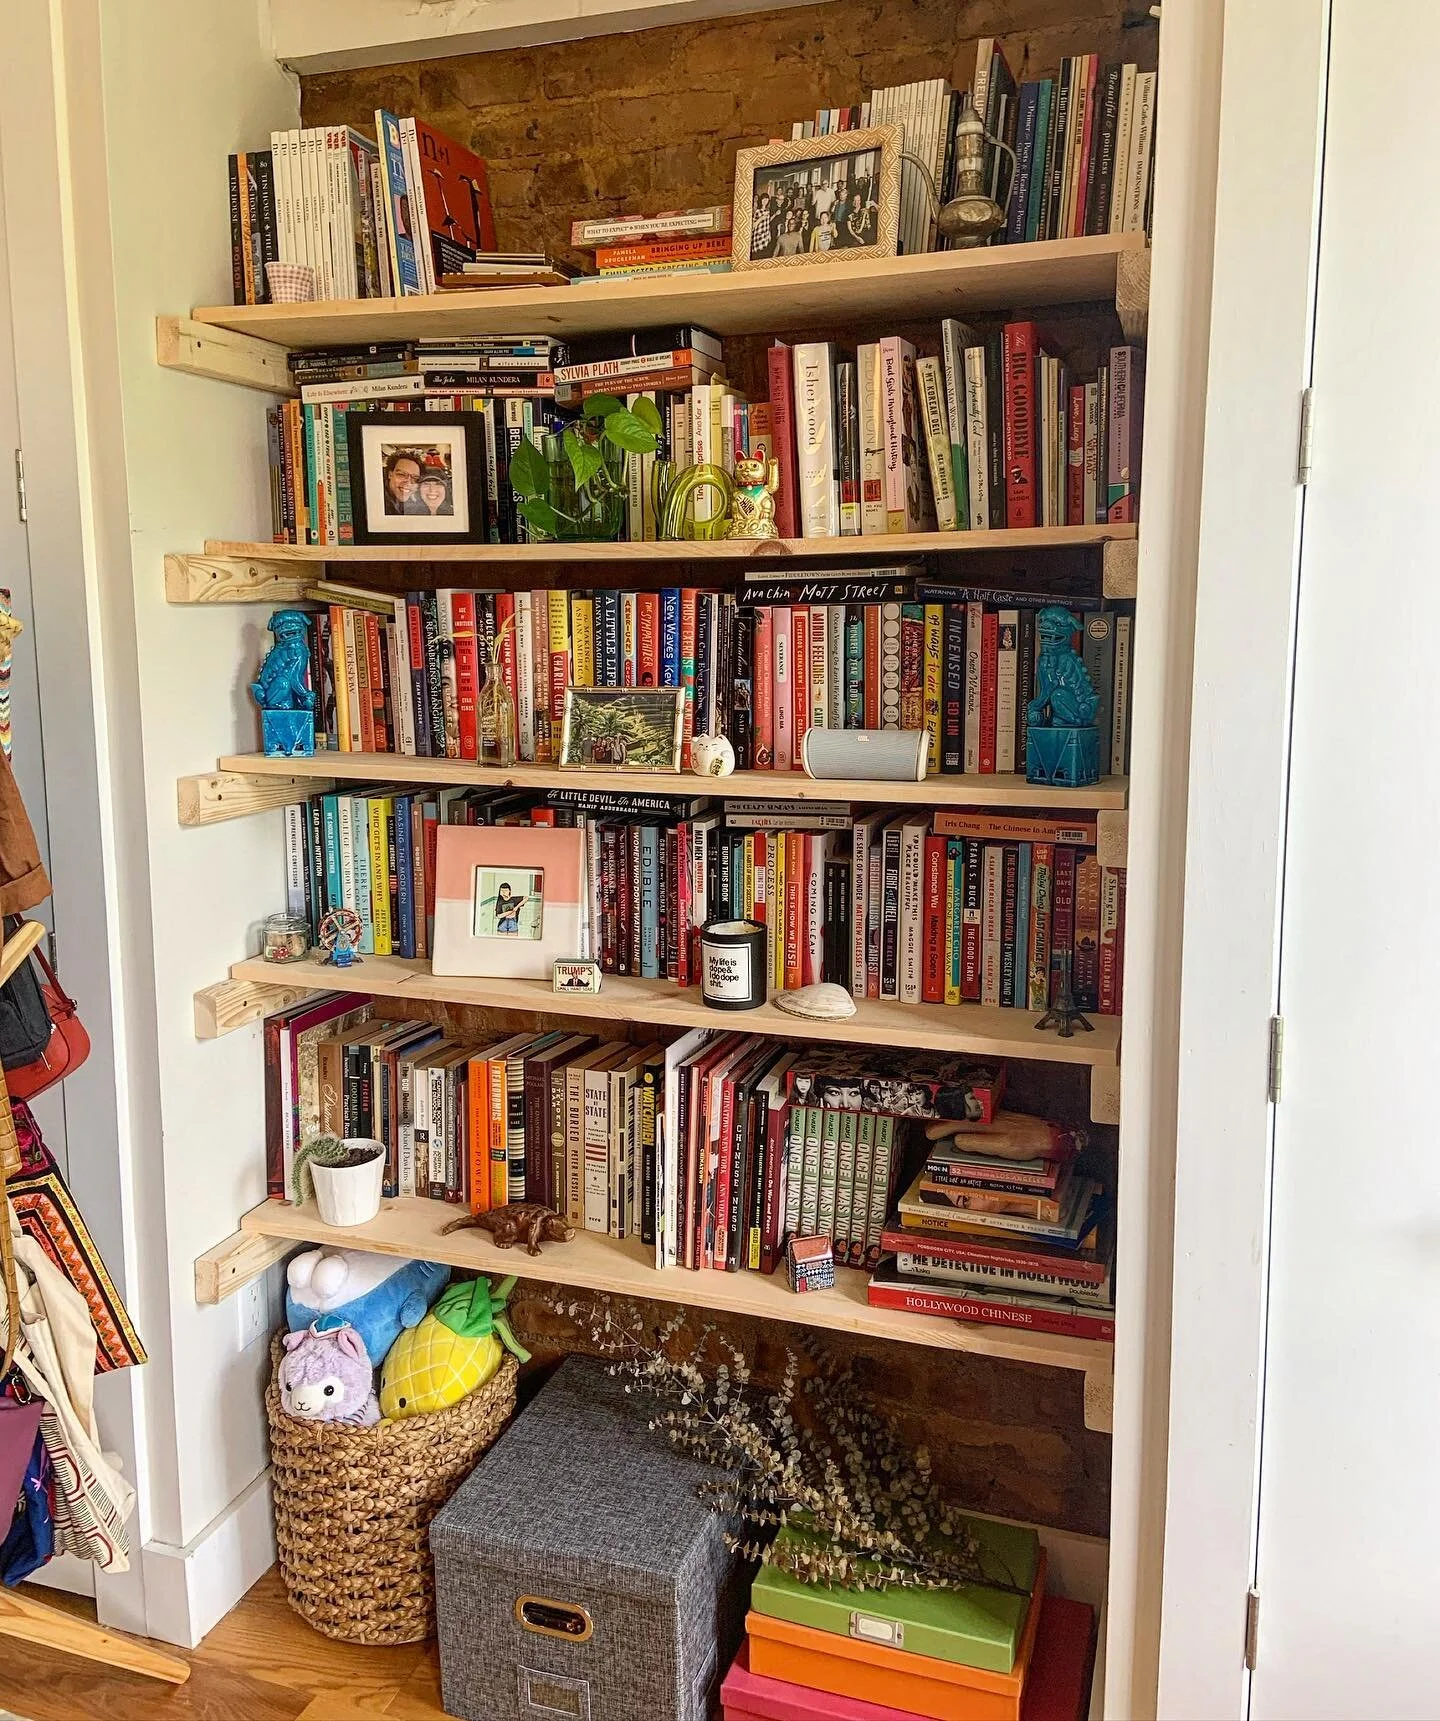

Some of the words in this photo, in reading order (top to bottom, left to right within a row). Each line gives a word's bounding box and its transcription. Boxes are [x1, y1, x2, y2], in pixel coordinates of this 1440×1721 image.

[1106, 71, 1118, 118] Beautiful
[1142, 77, 1152, 103] William
[1024, 106, 1035, 132] Primer
[1140, 104, 1150, 126] Carlos
[1022, 142, 1032, 163] Poets
[1101, 132, 1112, 175] pointless
[1138, 126, 1147, 155] Williams
[1018, 173, 1028, 202] Readers
[1133, 160, 1144, 210] IMAGINATIONS
[1014, 210, 1025, 236] Poetry
[1015, 332, 1026, 348] The
[561, 366, 589, 381] SYLVIA
[592, 362, 620, 376] PLATH
[886, 357, 894, 376] Bad
[924, 372, 933, 383] MY
[1012, 352, 1028, 380] BIG
[1116, 351, 1126, 384] SOUTHERN
[372, 384, 386, 392] Milan
[432, 375, 442, 384] The
[442, 375, 456, 384] Joke
[466, 376, 488, 384] MILAN
[885, 377, 896, 397] Girls
[804, 364, 821, 447] Isherwood
[926, 385, 938, 416] KOREAN
[944, 366, 952, 388] ANNA
[950, 405, 958, 432] WONG
[968, 376, 984, 418] Perpetually
[1116, 384, 1126, 418] CALIFORNIA
[886, 398, 897, 440] Throughout
[930, 418, 940, 436] DELI
[972, 420, 986, 438] Cool
[1012, 384, 1030, 460] GOODBYE
[888, 441, 898, 472] History
[606, 596, 616, 605] A
[766, 586, 790, 599] Chin
[666, 596, 676, 620] New
[682, 599, 694, 626] TRUST
[698, 606, 706, 620] All
[355, 618, 366, 662] GOLDEN
[606, 608, 616, 654] LITTLE
[640, 612, 654, 668] SYMPATHIZER
[698, 622, 706, 639] You
[812, 612, 825, 642] MINOR
[426, 621, 438, 684] REMEMBERING
[666, 624, 676, 658] Waves
[682, 630, 694, 670] EXERCISE
[737, 622, 748, 676] Orientalism
[948, 618, 962, 690] INCENSED
[358, 666, 367, 686] BOY
[554, 655, 564, 690] CHARLIE
[606, 658, 617, 687] LIFE
[697, 662, 705, 682] Ever
[812, 645, 825, 684] FEELINGS
[430, 686, 440, 732] SHANGHAI
[554, 694, 564, 717] CHAN
[696, 684, 705, 710] Know
[947, 701, 960, 716] ED
[778, 720, 784, 730] MA
[947, 718, 960, 736] LIN
[396, 804, 406, 844] CHASING
[856, 828, 864, 842] THE
[694, 830, 704, 845] MAD
[695, 846, 704, 861] MEN
[856, 842, 864, 862] SENSE
[969, 842, 978, 868] PEARL
[642, 846, 652, 908] EDIBLE
[696, 862, 704, 894] UNBUTTONED
[767, 844, 776, 896] PROCESS
[856, 864, 863, 872] OF
[930, 852, 940, 894] Constance
[969, 872, 978, 881] S.
[810, 872, 818, 914] COMING
[930, 895, 939, 908] Wu
[968, 885, 978, 907] BUCK
[634, 934, 640, 943] IN
[790, 930, 796, 940] WE
[810, 920, 818, 955] CLEAN
[967, 928, 975, 940] THE
[709, 956, 719, 966] My
[719, 957, 730, 966] life
[730, 957, 737, 966] is
[788, 942, 798, 966] RISE
[868, 944, 879, 976] FAIREST
[967, 942, 975, 959] GOOD
[556, 966, 593, 976] TRUMP'S
[709, 972, 712, 980] I
[712, 972, 722, 980] do
[722, 974, 739, 983] dope
[710, 964, 726, 975] dope
[726, 966, 732, 974] &
[966, 962, 975, 982] EARTH
[1004, 952, 1012, 977] WESLEY
[1004, 978, 1012, 996] YANG
[402, 1066, 410, 1077] The
[402, 1078, 410, 1090] GOD
[351, 1082, 359, 1122] DOORMEN
[402, 1092, 410, 1119] Delusion
[491, 1065, 502, 1121] FREAKONOMICS
[570, 1086, 580, 1102] THE
[586, 1088, 607, 1100] STATE
[570, 1107, 580, 1142] BURIED
[586, 1105, 608, 1118] STATE
[642, 1086, 654, 1146] WATCHMEN
[722, 1090, 730, 1134] CHINATOWN
[402, 1122, 411, 1150] Richard
[571, 1150, 579, 1170] PETER
[720, 1154, 728, 1174] YORK
[790, 1134, 802, 1170] ONCE
[403, 1152, 411, 1182] Dawkins
[572, 1172, 580, 1202] HESSLER
[788, 1180, 801, 1206] WAS
[786, 1208, 800, 1231] YOU
[921, 1218, 949, 1228] NOTICE
[906, 1297, 979, 1315] HOLLYWOOD
[981, 1308, 1033, 1323] CHINESE
